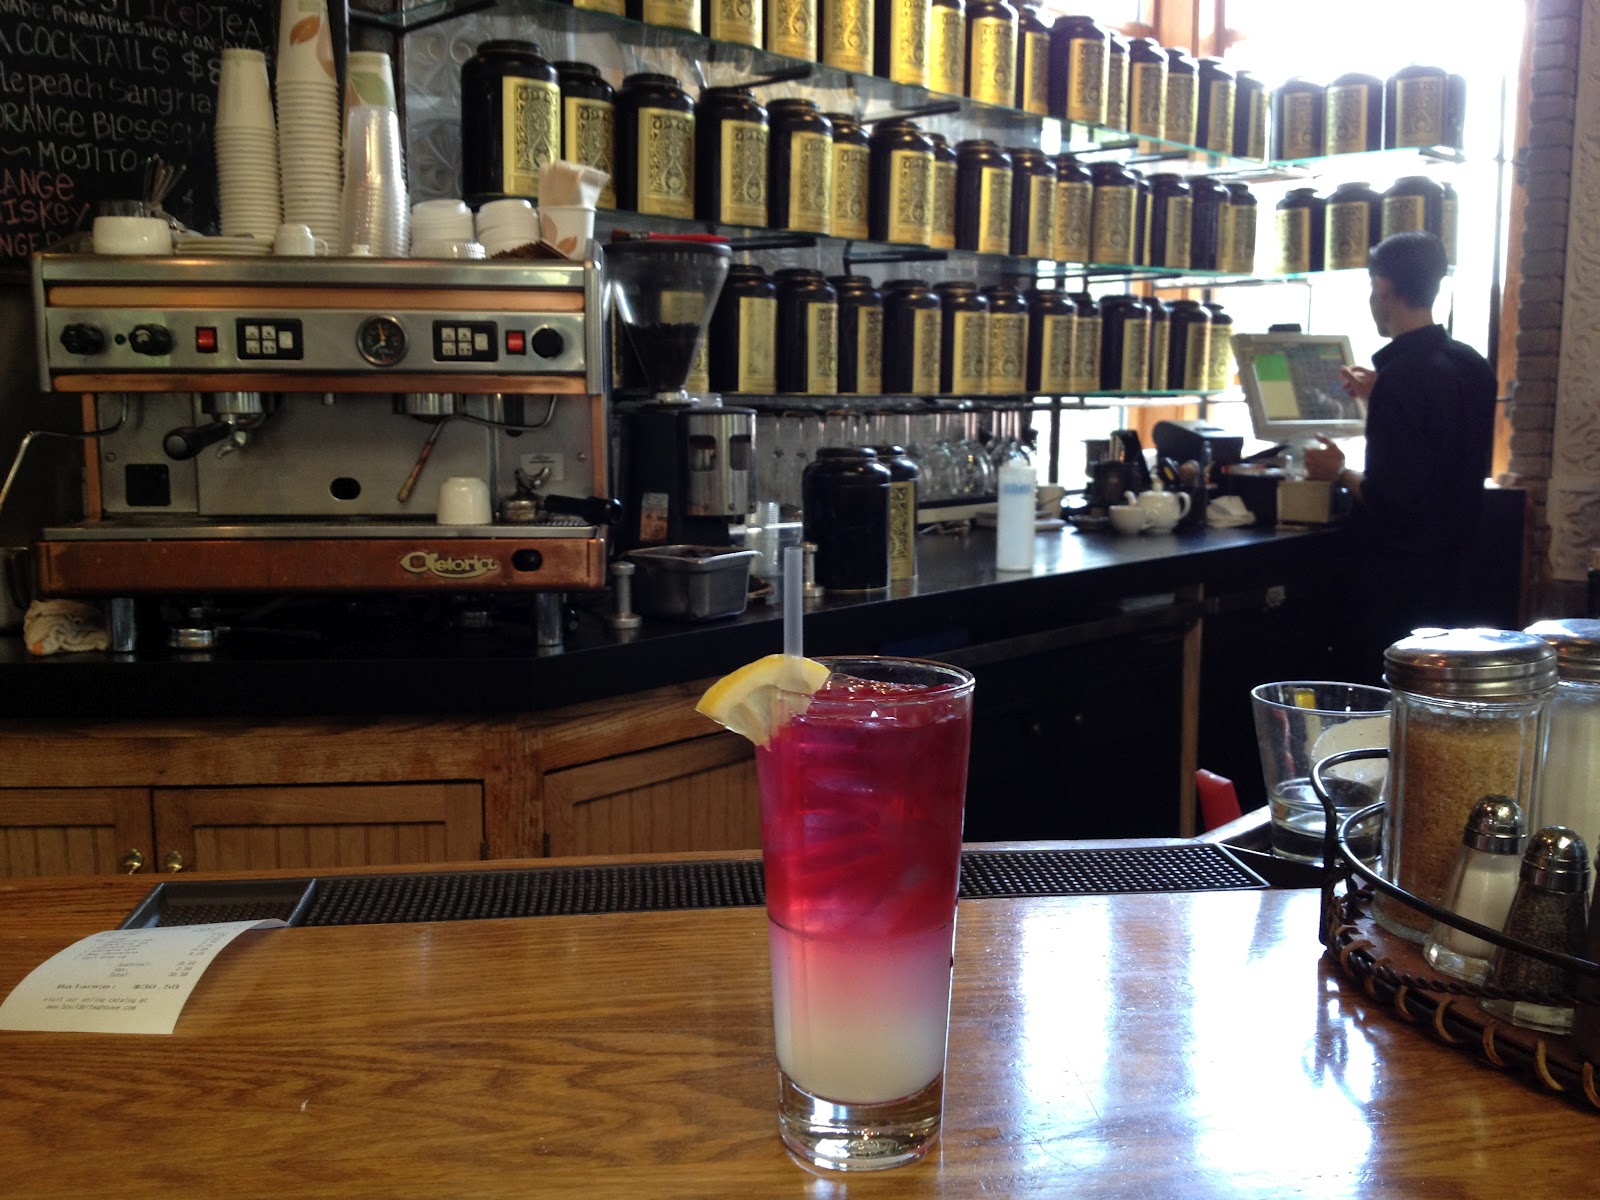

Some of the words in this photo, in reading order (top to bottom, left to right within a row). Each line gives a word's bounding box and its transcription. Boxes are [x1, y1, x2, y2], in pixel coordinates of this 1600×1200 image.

[16, 22, 171, 75] COCKTAILS
[28, 72, 103, 108] peach
[38, 141, 138, 172] MOJITO
